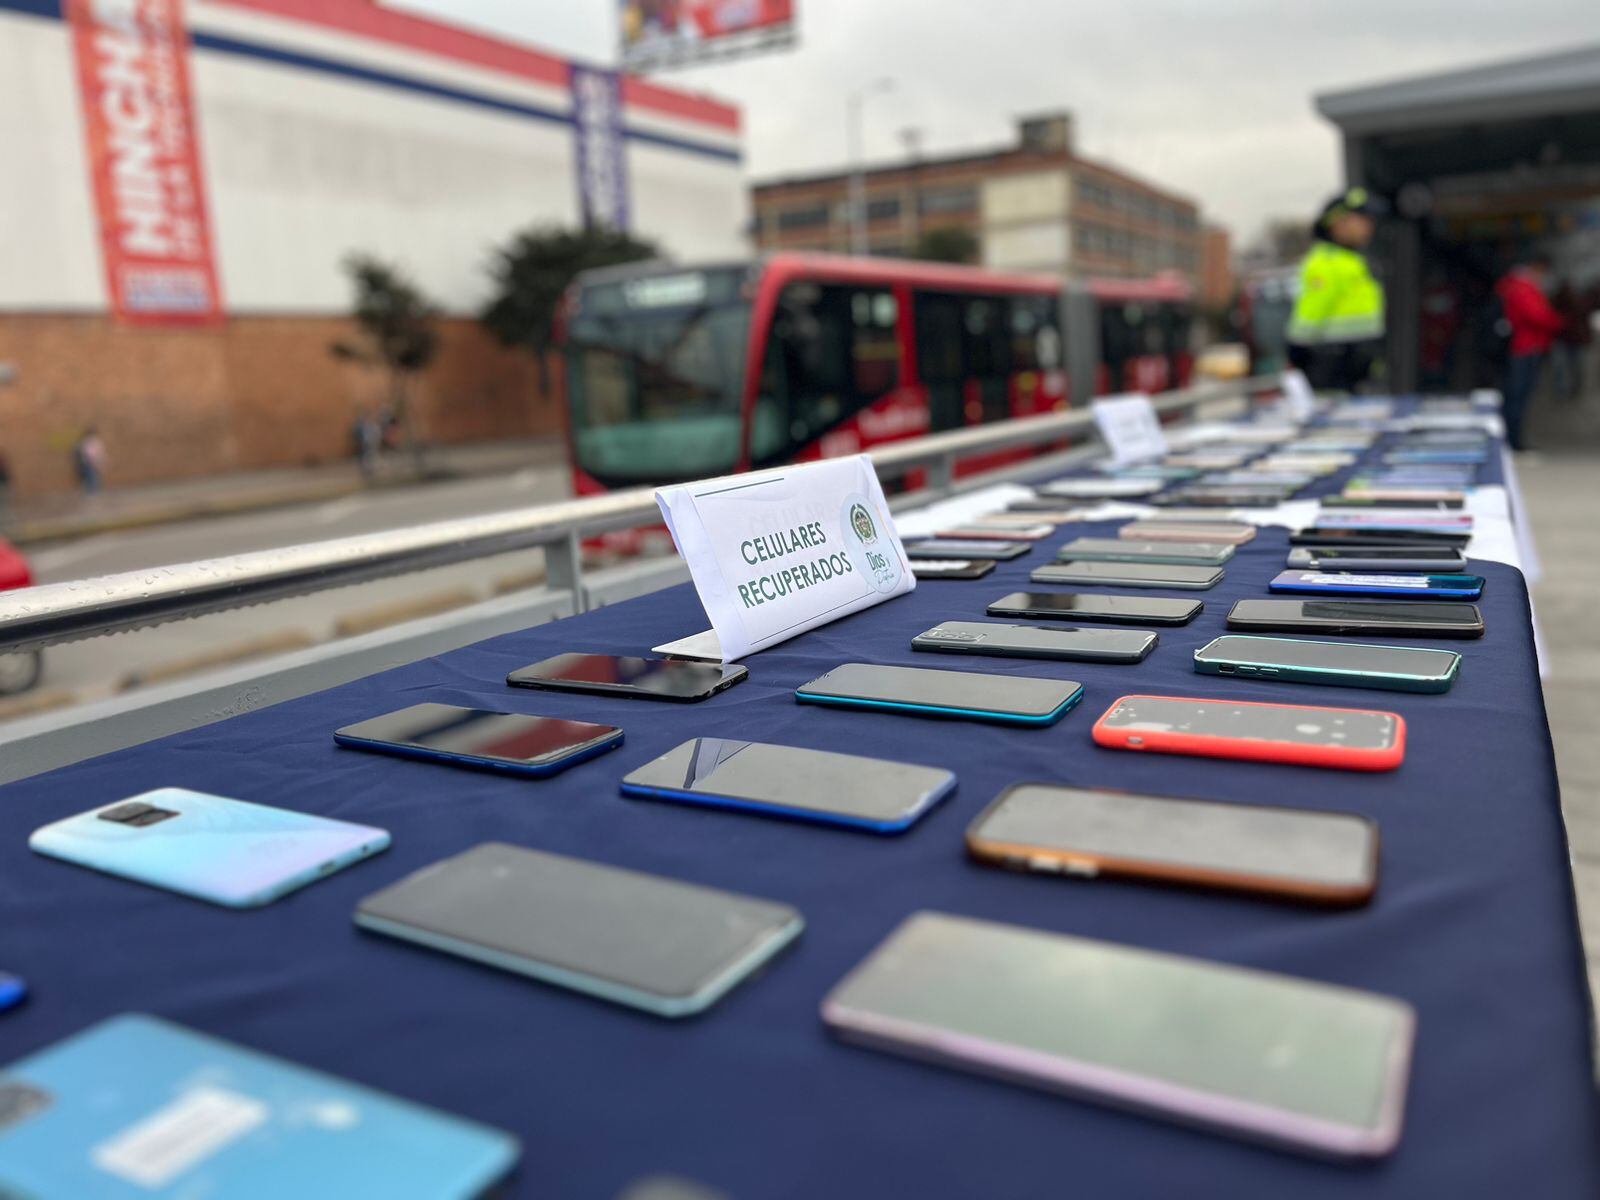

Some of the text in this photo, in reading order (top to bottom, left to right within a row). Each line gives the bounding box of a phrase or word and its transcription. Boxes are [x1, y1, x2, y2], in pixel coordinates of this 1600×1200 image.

[740, 521, 827, 565] CELULARES
[865, 551, 886, 571] Dios
[738, 551, 853, 608] RECUPERADOS
